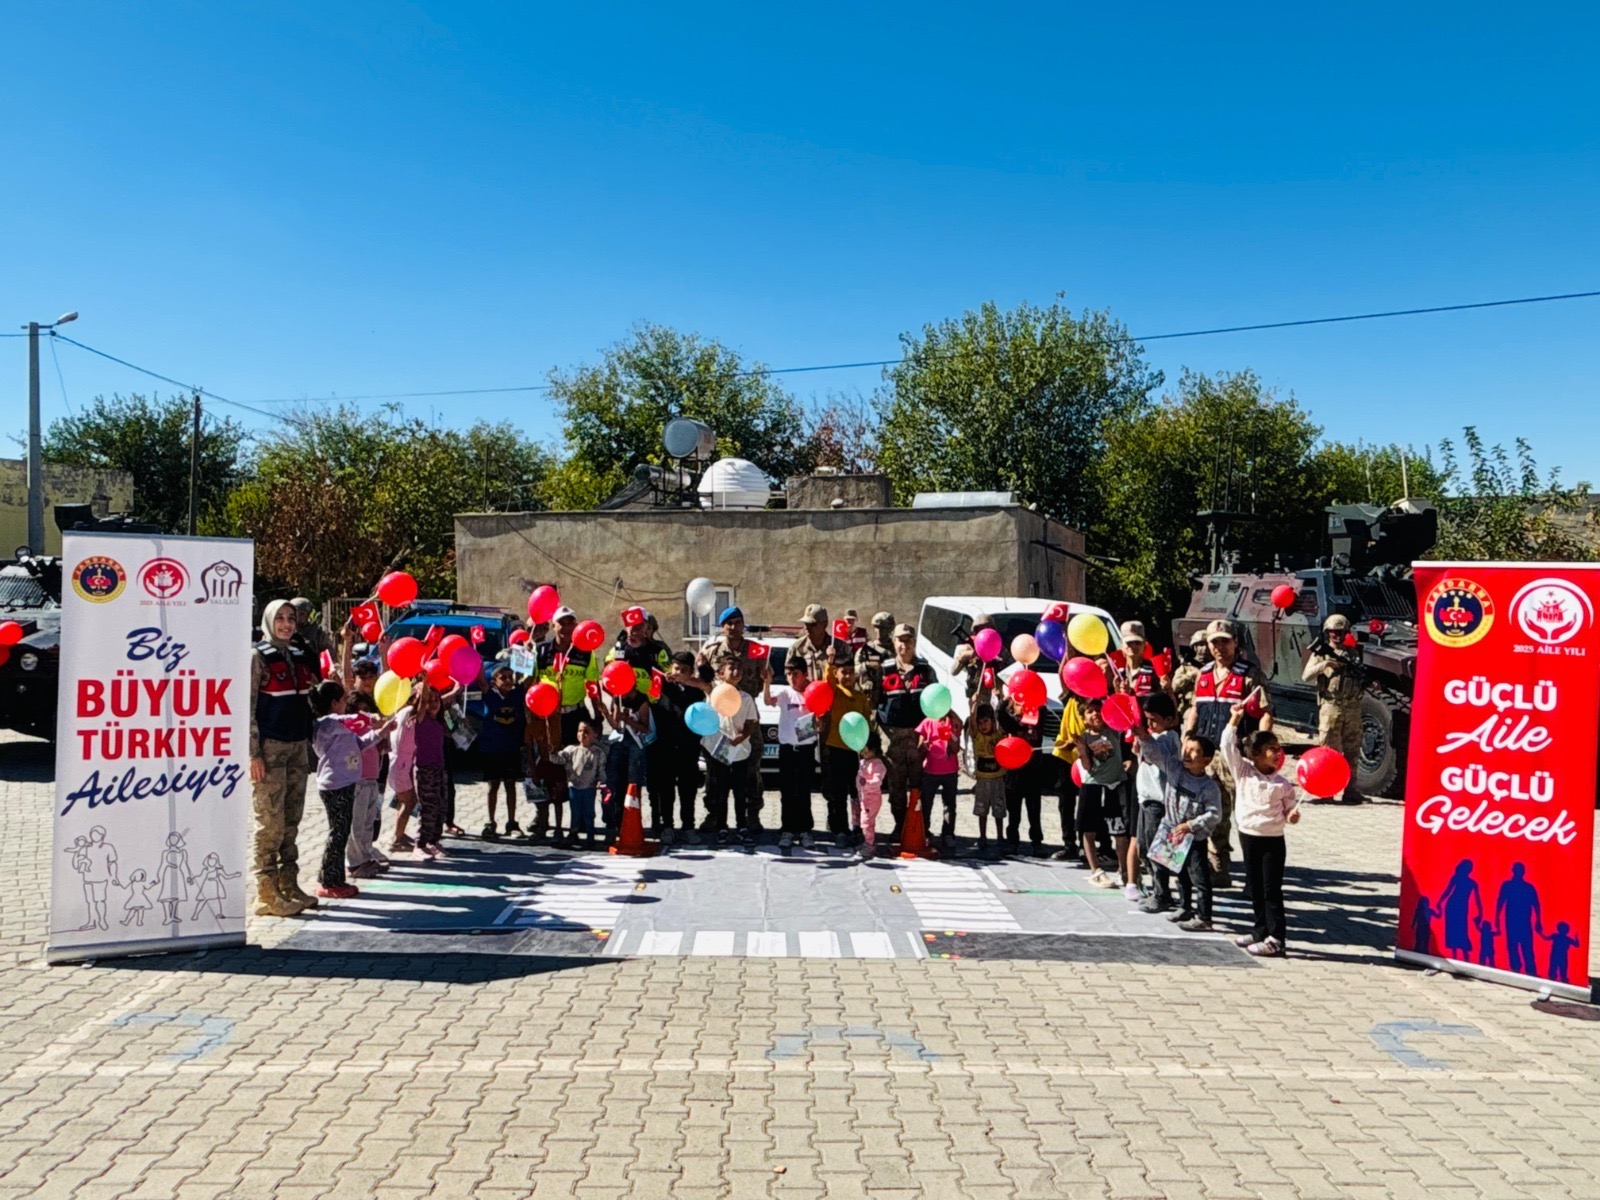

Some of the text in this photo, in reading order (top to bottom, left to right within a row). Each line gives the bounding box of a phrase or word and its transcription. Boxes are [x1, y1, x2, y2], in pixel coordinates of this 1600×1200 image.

[1428, 580, 1491, 608] JANDARMA
[126, 627, 190, 673] Biz
[1512, 644, 1586, 657] 2025 AİLE YILI
[76, 669, 232, 718] BÜYÜK
[1443, 676, 1557, 713] GÜÇLÜ
[76, 720, 232, 761] TÜRKİYE
[1436, 714, 1553, 754] Aile
[60, 758, 245, 816] Ailesiyiz
[1440, 763, 1555, 802] GÜÇLÜ
[1415, 795, 1578, 845] Gelecek
